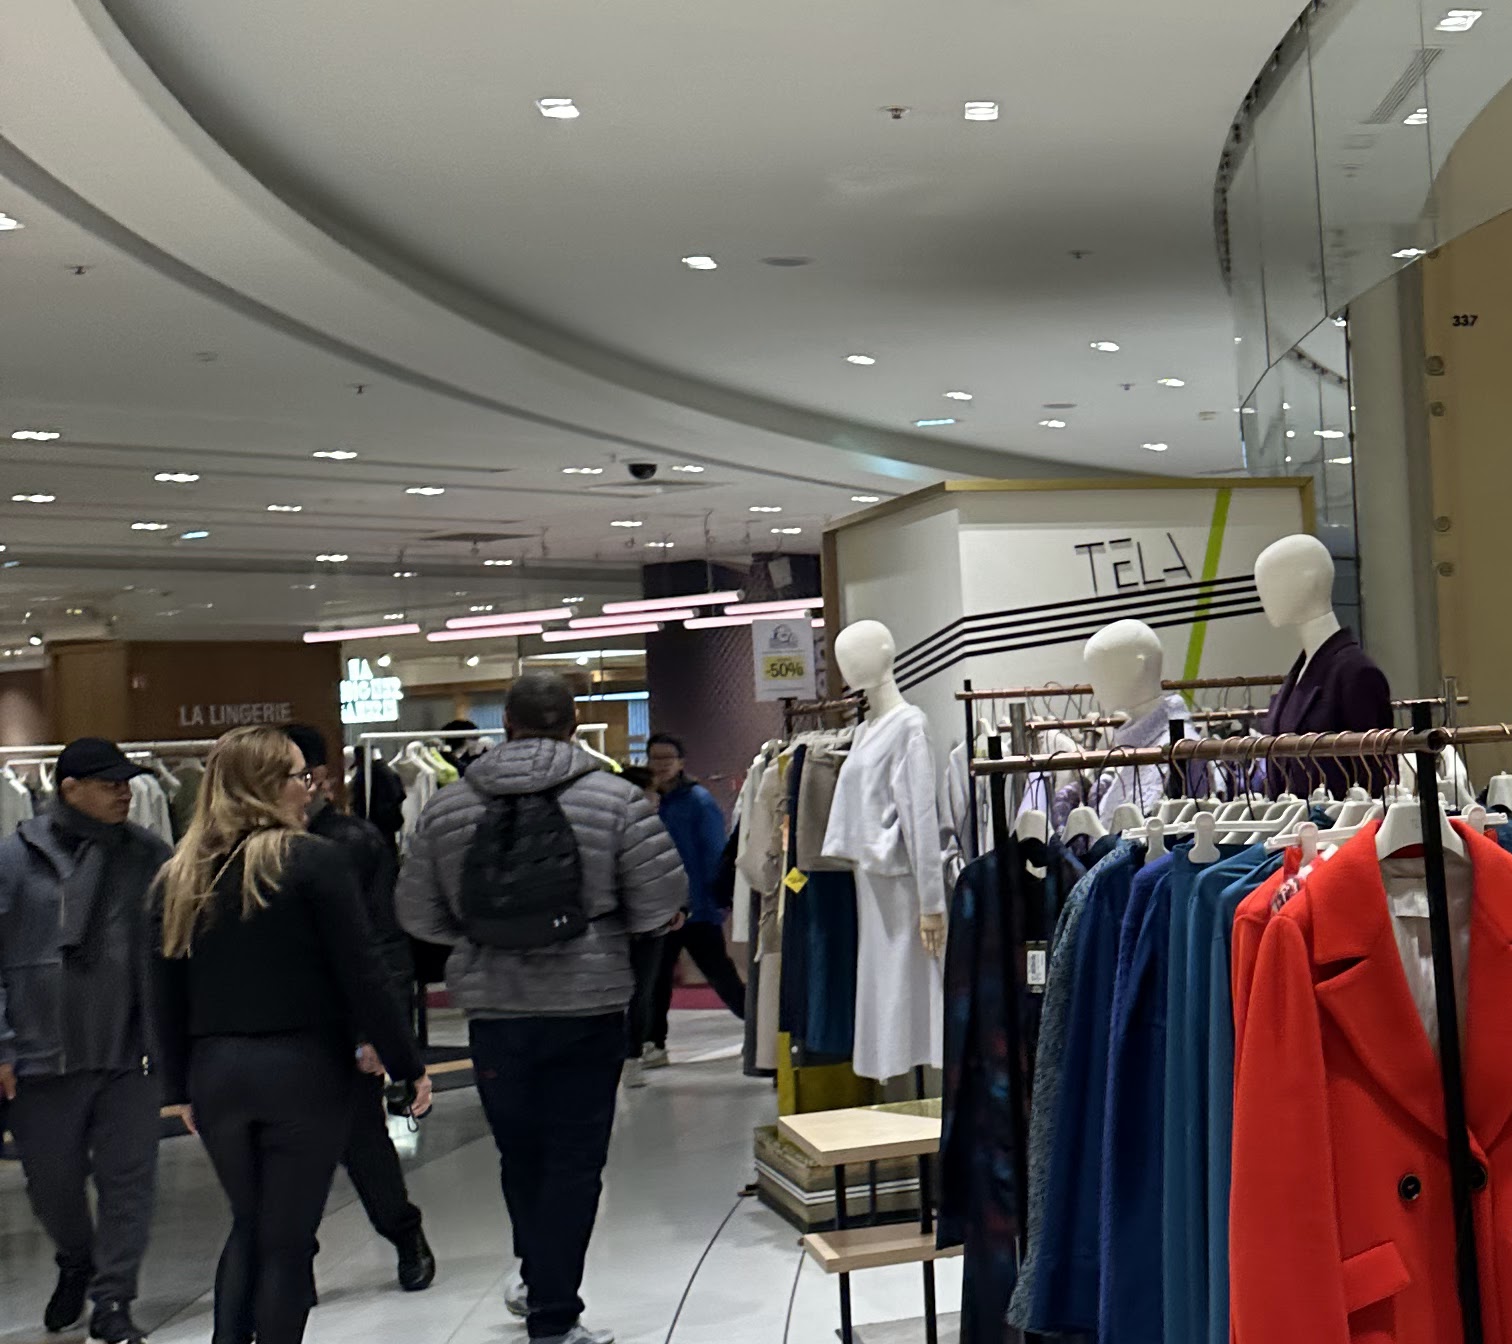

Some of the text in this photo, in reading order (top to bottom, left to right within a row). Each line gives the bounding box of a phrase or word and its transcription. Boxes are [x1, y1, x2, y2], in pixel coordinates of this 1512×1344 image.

[1452, 314, 1479, 327] 337
[1074, 531, 1193, 596] TELA
[180, 702, 292, 726] LA LINGERIE
